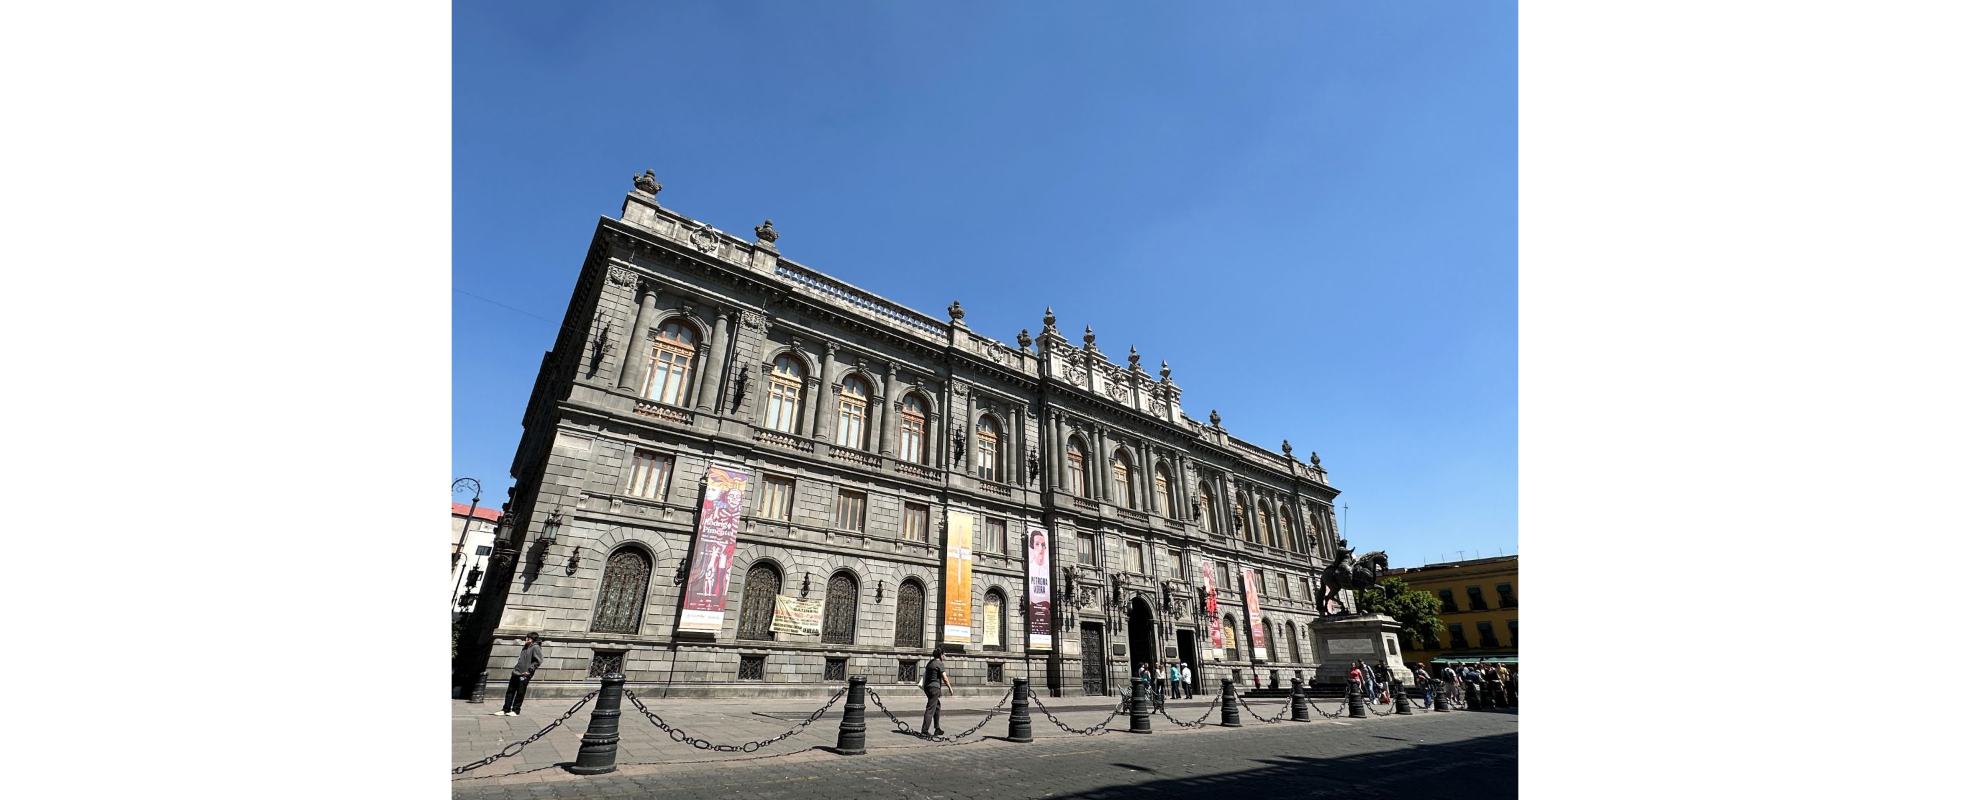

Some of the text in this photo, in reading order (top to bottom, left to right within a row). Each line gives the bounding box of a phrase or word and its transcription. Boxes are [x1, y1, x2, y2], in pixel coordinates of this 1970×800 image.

[704, 518, 732, 530] Rodrigo
[702, 526, 734, 536] Pimentel
[1030, 576, 1048, 586] PETRONA
